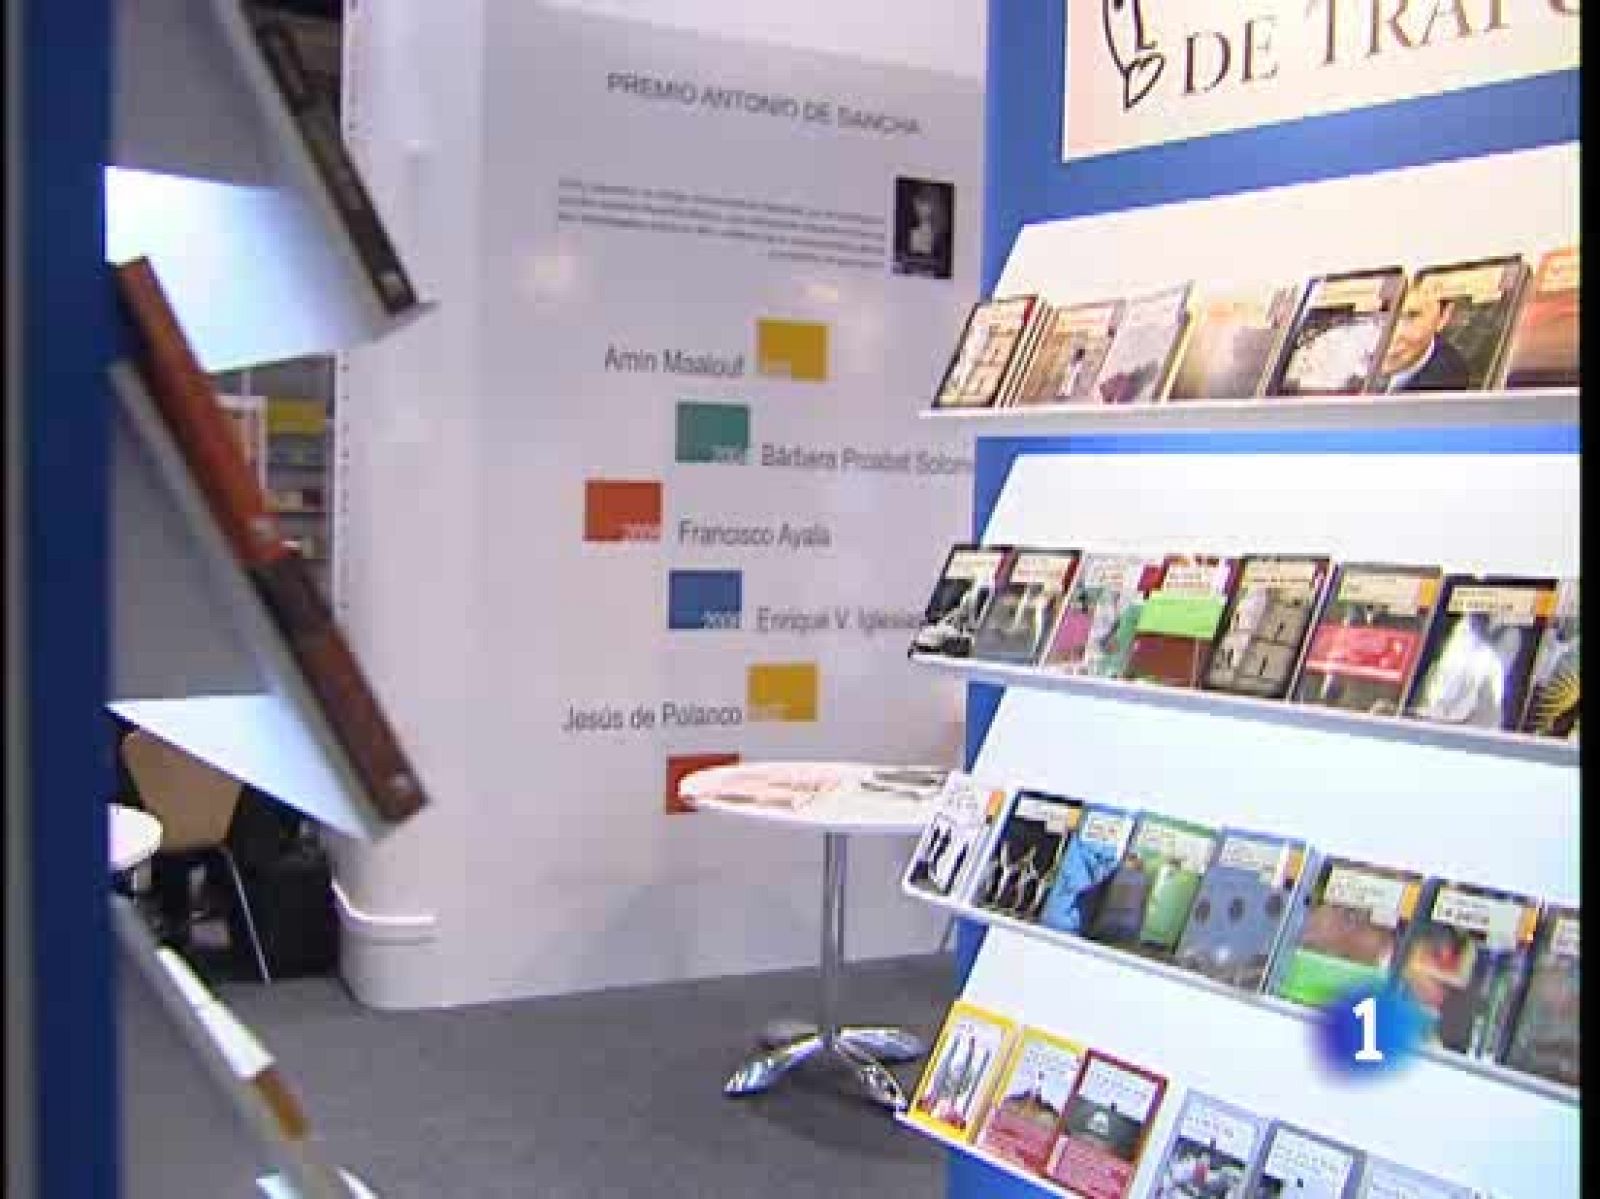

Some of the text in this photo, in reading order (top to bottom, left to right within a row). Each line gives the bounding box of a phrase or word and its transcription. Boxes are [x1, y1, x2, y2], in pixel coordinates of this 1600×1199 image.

[1184, 14, 1279, 95] DE
[607, 71, 698, 104] PREMIO
[701, 86, 798, 119] ANTONIO
[802, 100, 831, 125] DE
[604, 344, 656, 373] Amin
[678, 519, 831, 551] Francisco Ayala
[631, 704, 655, 731] de
[662, 700, 743, 729] Polanco
